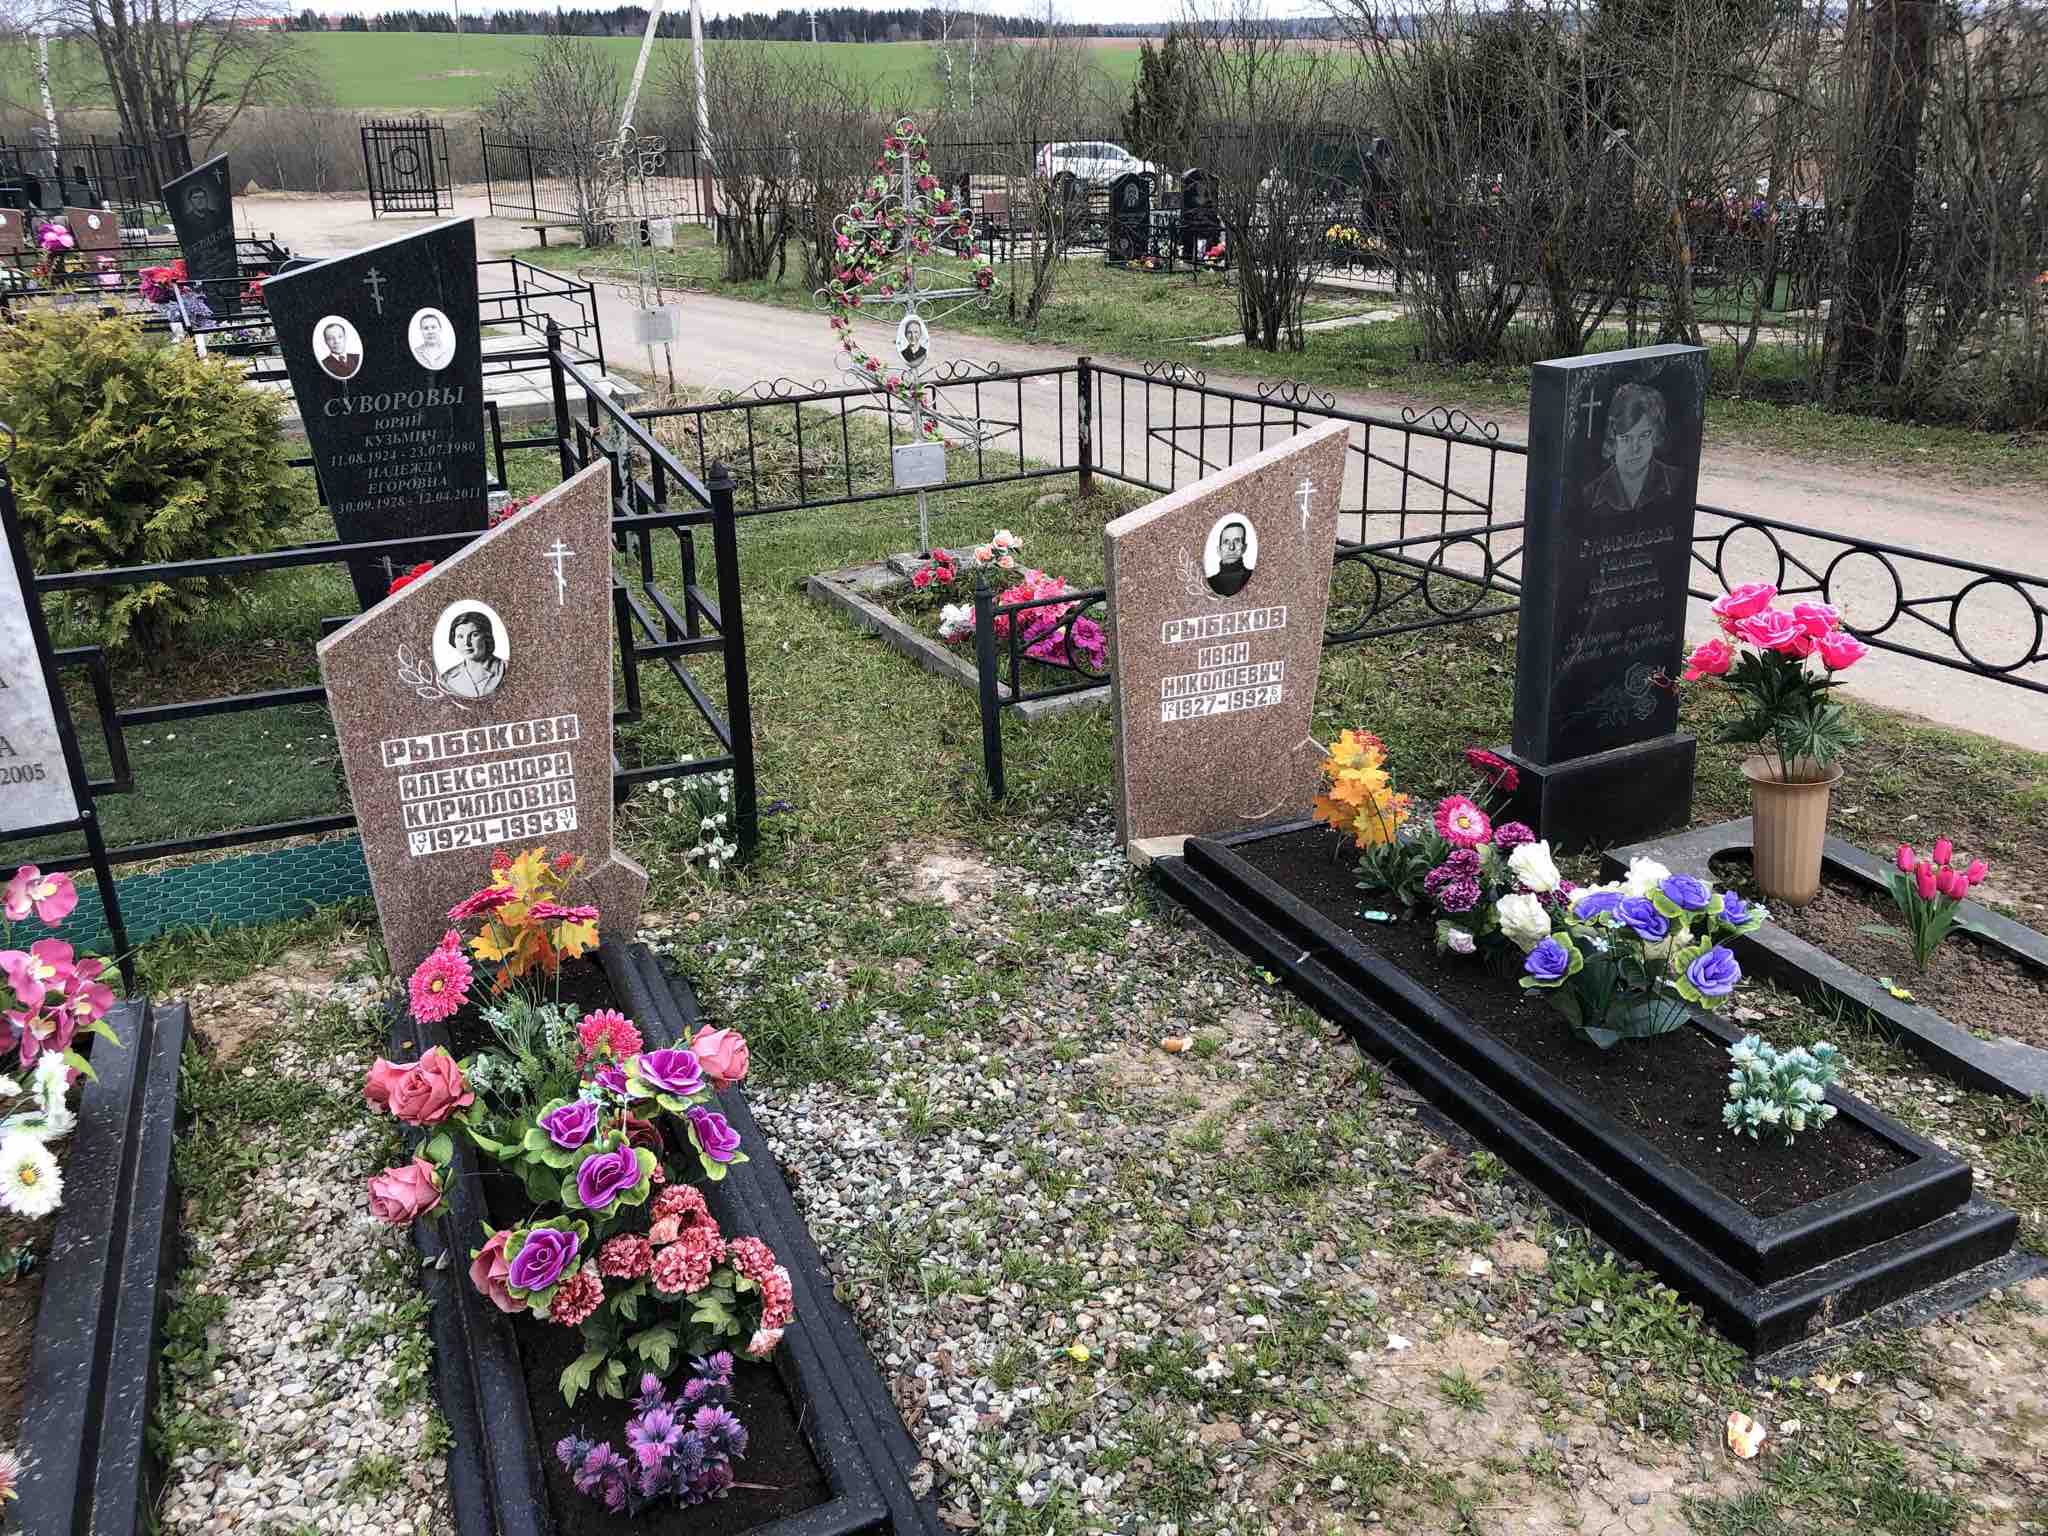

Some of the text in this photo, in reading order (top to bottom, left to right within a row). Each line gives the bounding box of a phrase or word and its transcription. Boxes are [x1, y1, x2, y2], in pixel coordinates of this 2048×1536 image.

[323, 386, 465, 417] СУВОРОВЫ
[368, 462, 443, 480] НАДЕЖДА
[368, 477, 448, 495] ЕГОРОВНА
[1163, 607, 1286, 643] РЫБАКОВ
[1199, 642, 1249, 669] ИВАН
[1162, 661, 1284, 698] НИКОЛАЕВИЧ
[1176, 688, 1269, 718] 1927-1992
[382, 715, 579, 767] РЫБАКОВА
[400, 753, 573, 800] АЛЕКСАНДРА
[404, 780, 575, 828] КИРИЛЛОВНА
[430, 811, 559, 852] 1924-1993
